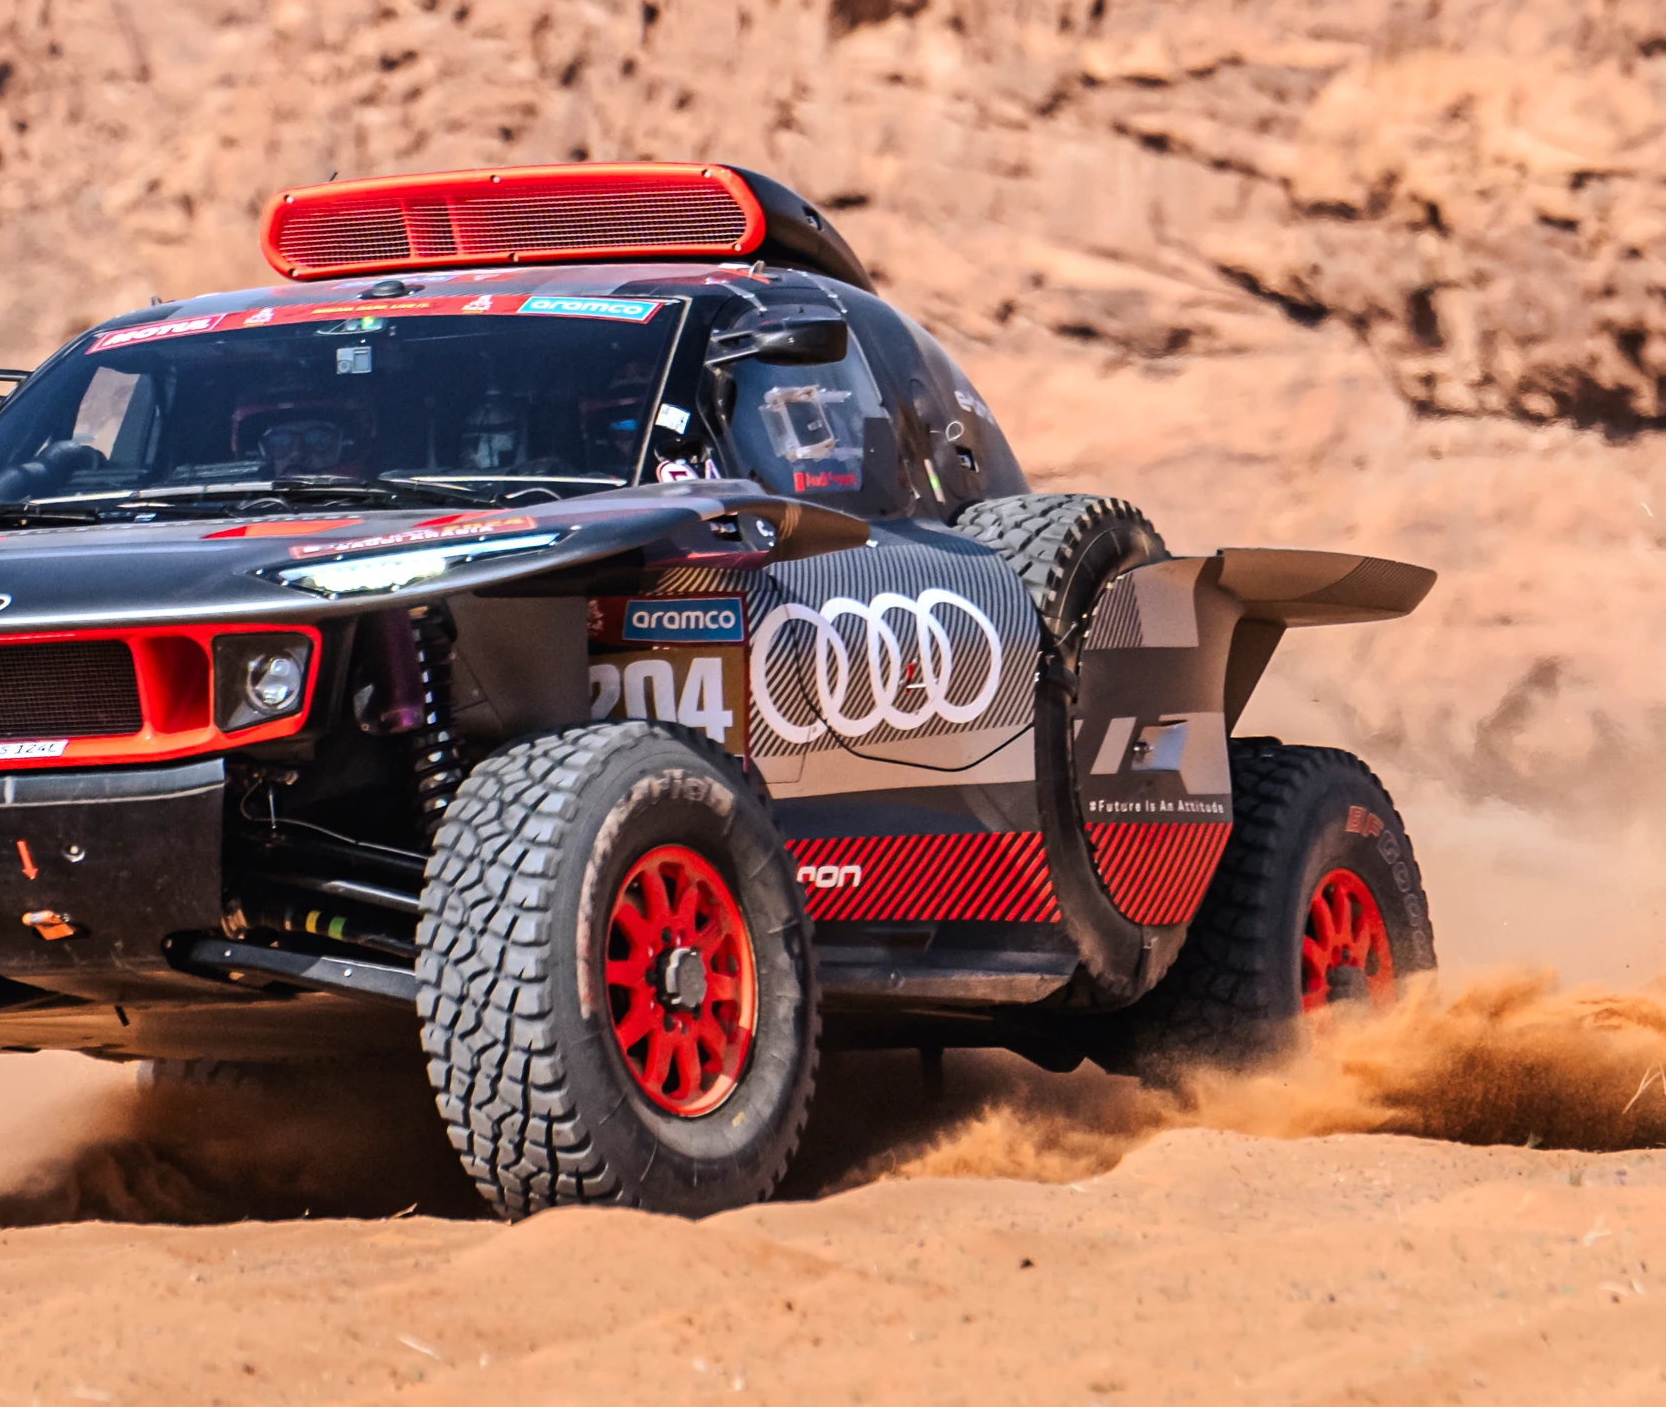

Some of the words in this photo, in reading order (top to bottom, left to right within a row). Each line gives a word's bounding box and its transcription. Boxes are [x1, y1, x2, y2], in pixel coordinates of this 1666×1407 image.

[530, 297, 643, 315] aramco
[102, 318, 212, 346] MOTUL
[633, 610, 736, 630] aramco
[588, 657, 734, 744] 204
[1089, 800, 1141, 812] #Future
[1159, 800, 1174, 812] An
[1177, 799, 1225, 813] Attitude
